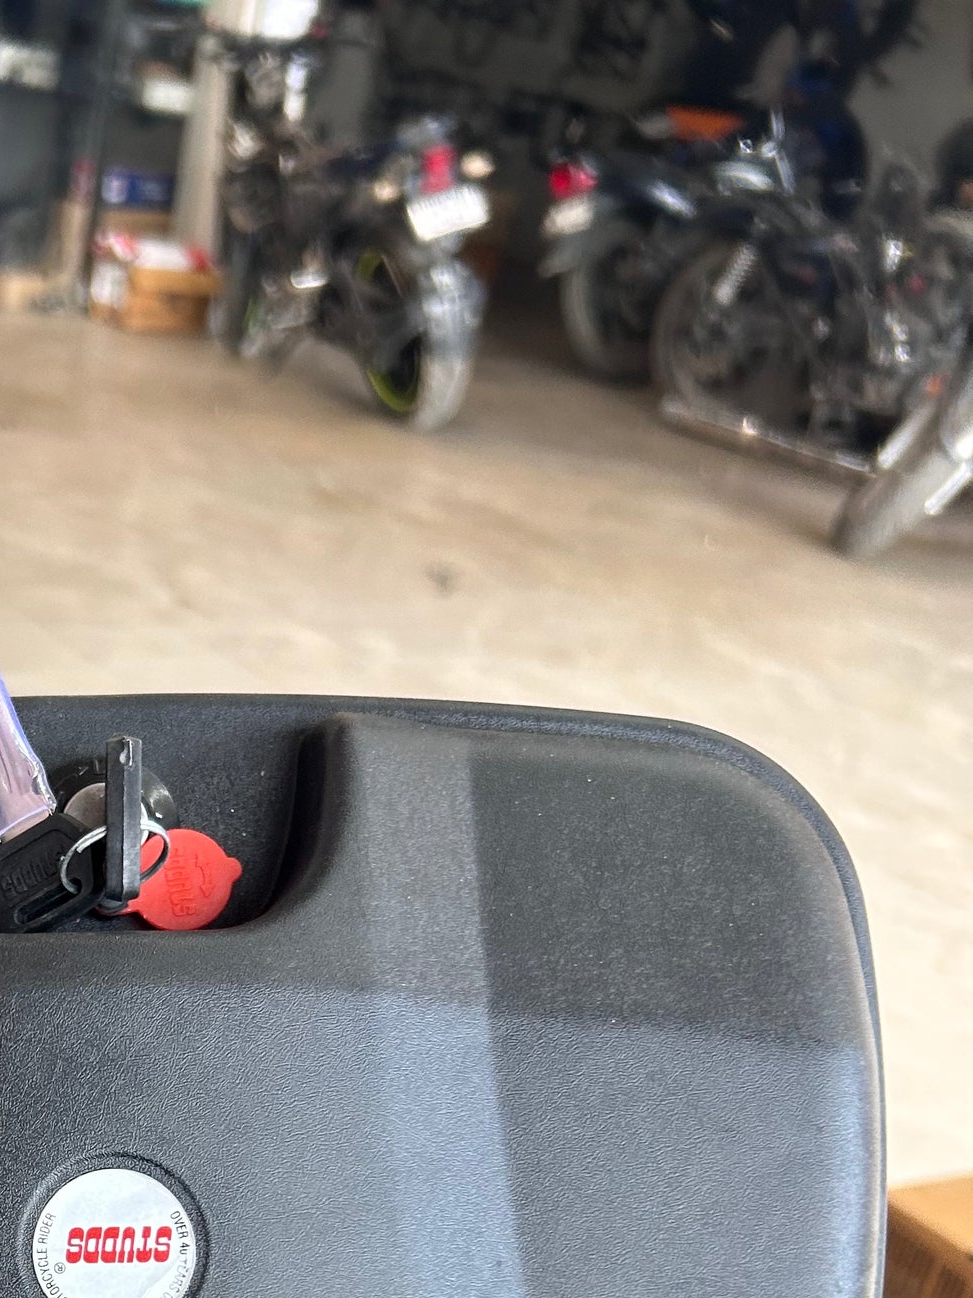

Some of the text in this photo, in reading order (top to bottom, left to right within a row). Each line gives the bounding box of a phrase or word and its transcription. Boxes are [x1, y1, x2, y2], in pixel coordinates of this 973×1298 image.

[37, 1212, 57, 1244] RIDER
[171, 1210, 189, 1239] OVER
[66, 1226, 172, 1263] STUDDS
